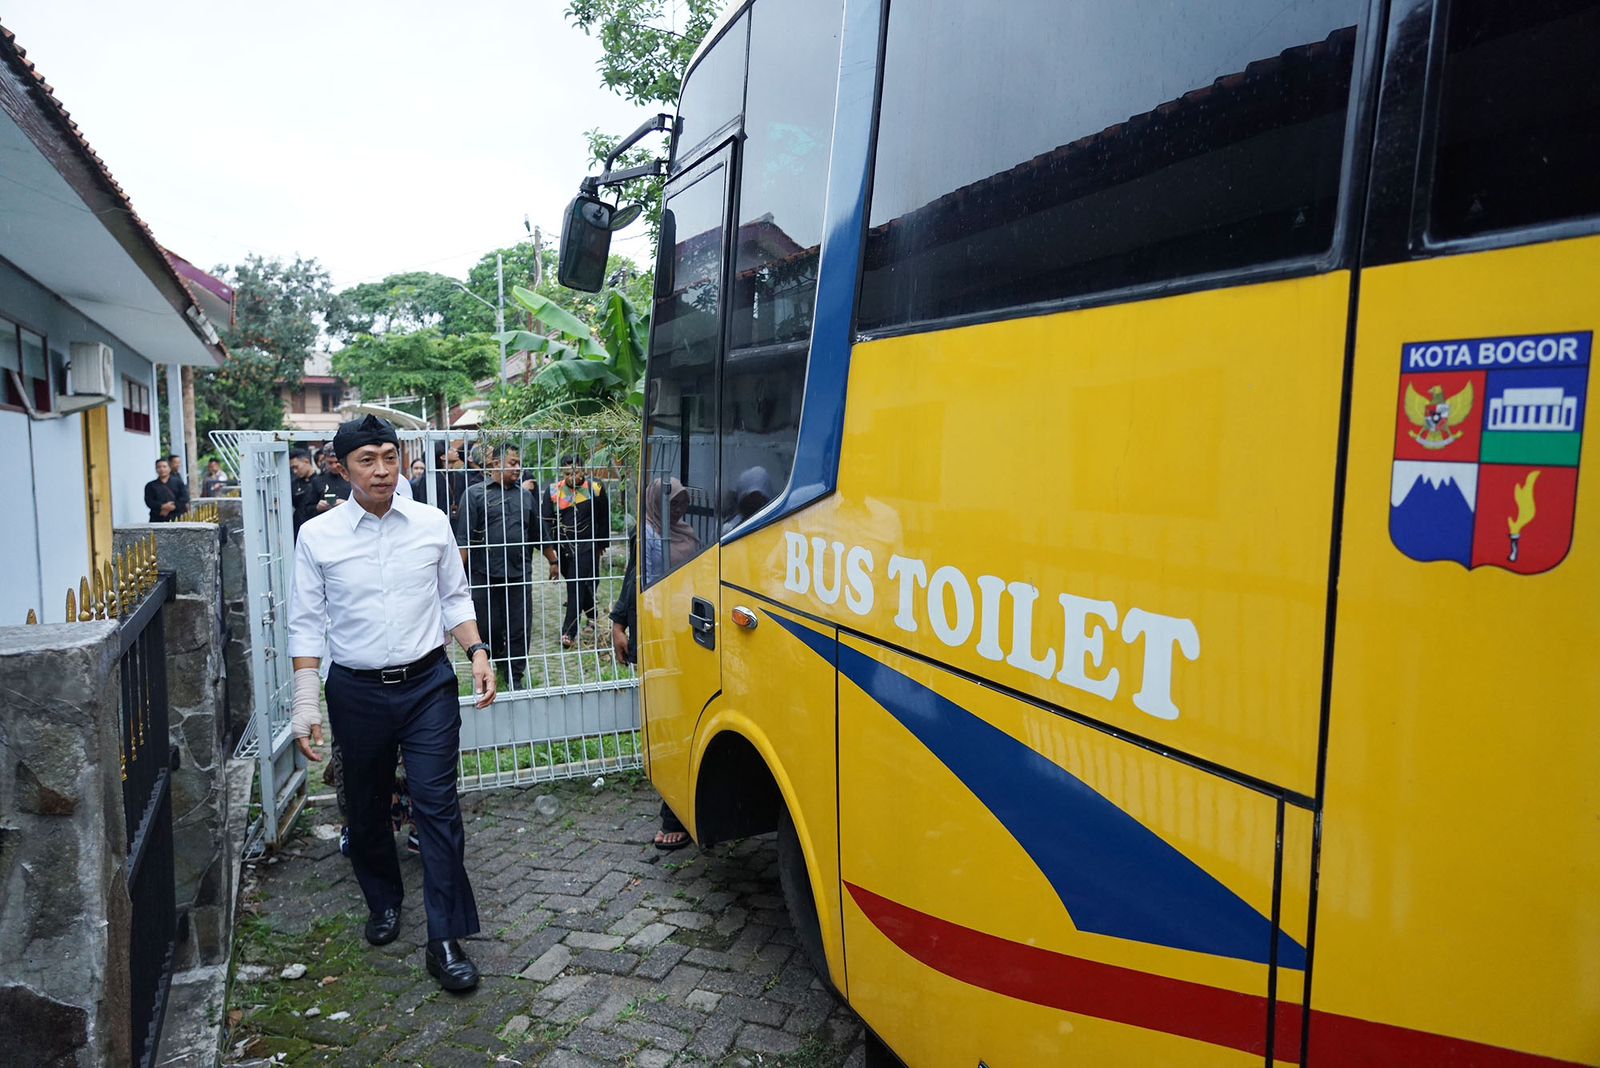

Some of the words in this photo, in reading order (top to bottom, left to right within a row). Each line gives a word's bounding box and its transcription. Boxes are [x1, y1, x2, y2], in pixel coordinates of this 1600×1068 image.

[1409, 344, 1472, 368] KOTA
[1478, 338, 1578, 365] BOGOR
[784, 531, 874, 616] BUS
[887, 554, 1200, 720] TOILET
